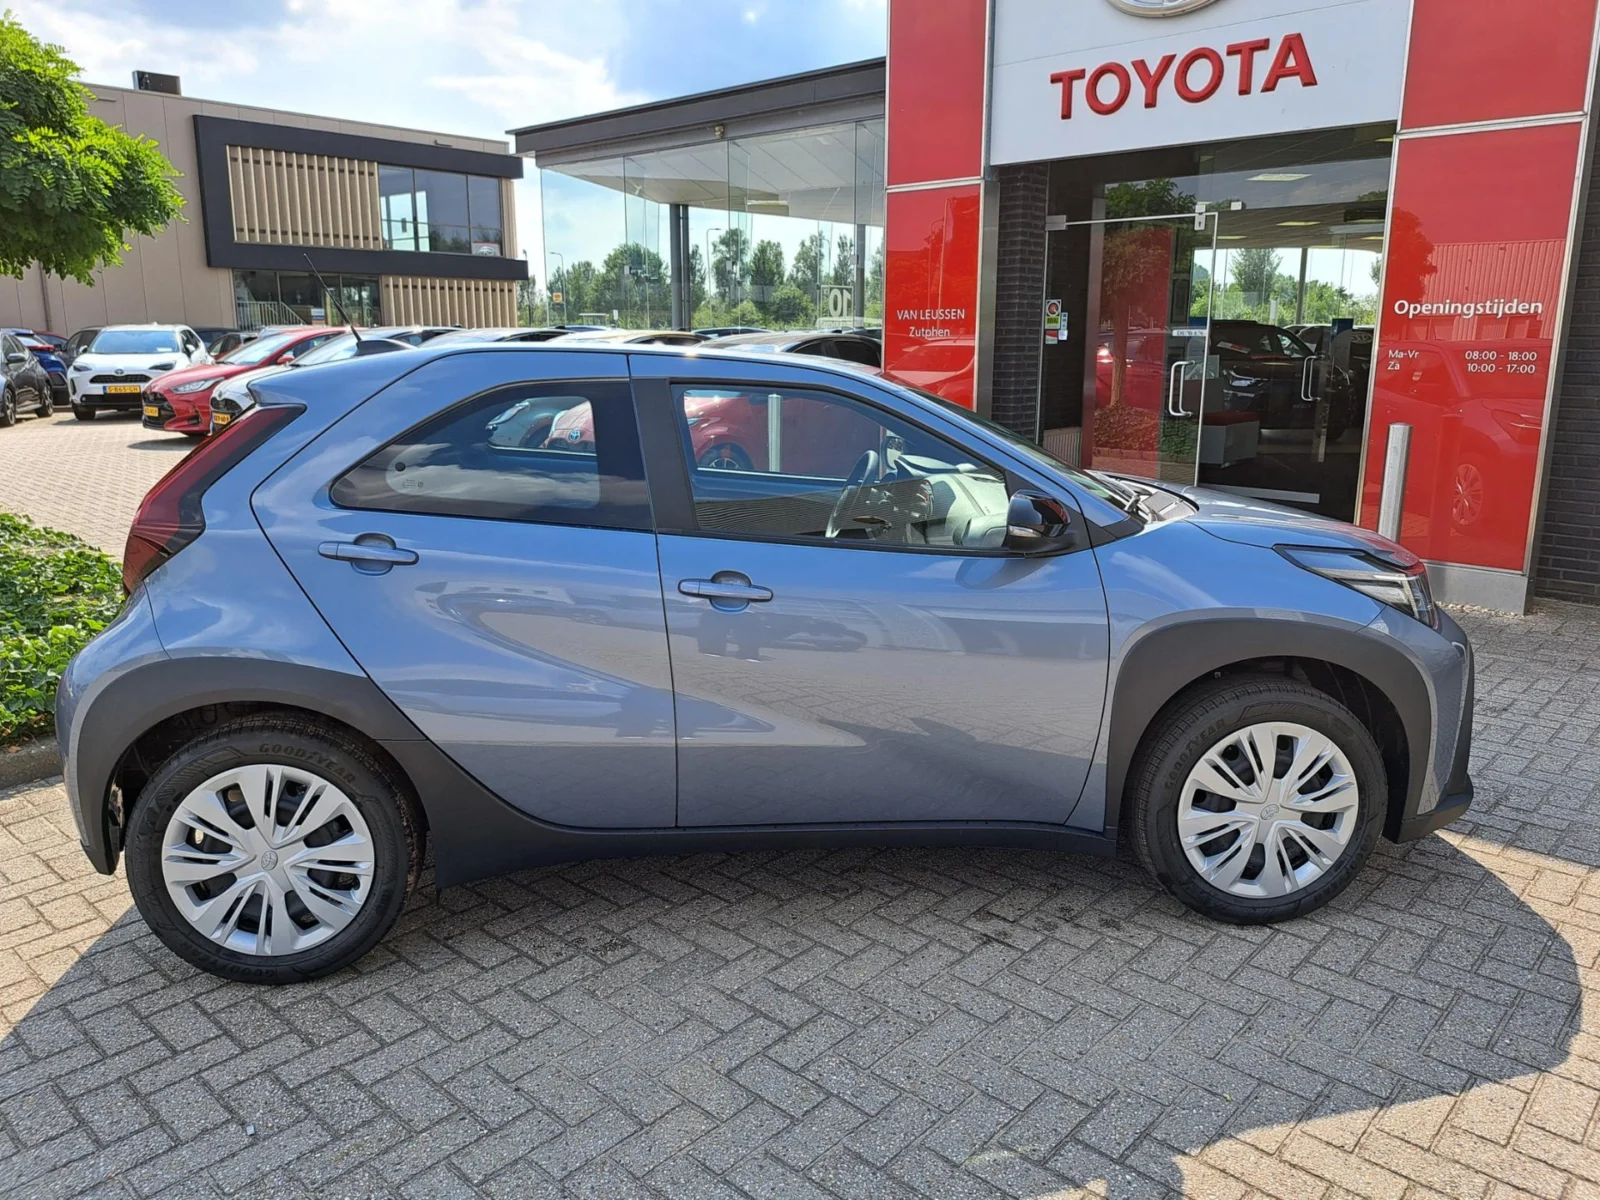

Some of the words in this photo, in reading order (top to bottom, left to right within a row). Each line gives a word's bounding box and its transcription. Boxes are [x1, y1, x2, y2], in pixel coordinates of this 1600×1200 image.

[1050, 33, 1318, 119] TOYOTA
[897, 310, 917, 320] VAN
[920, 309, 965, 320] LEUSSEN
[1394, 299, 1543, 318] Openingstijden
[909, 326, 950, 339] Zutphen
[1388, 350, 1419, 359] Ma-Vr
[1465, 351, 1497, 361] 08:00
[1508, 351, 1537, 361] 18:00
[1387, 361, 1400, 371] Za
[1467, 363, 1496, 373] 10:00
[1507, 364, 1536, 373] 17:00
[1165, 718, 1226, 790] GOODYEAR
[259, 743, 357, 784] GOODYEAR
